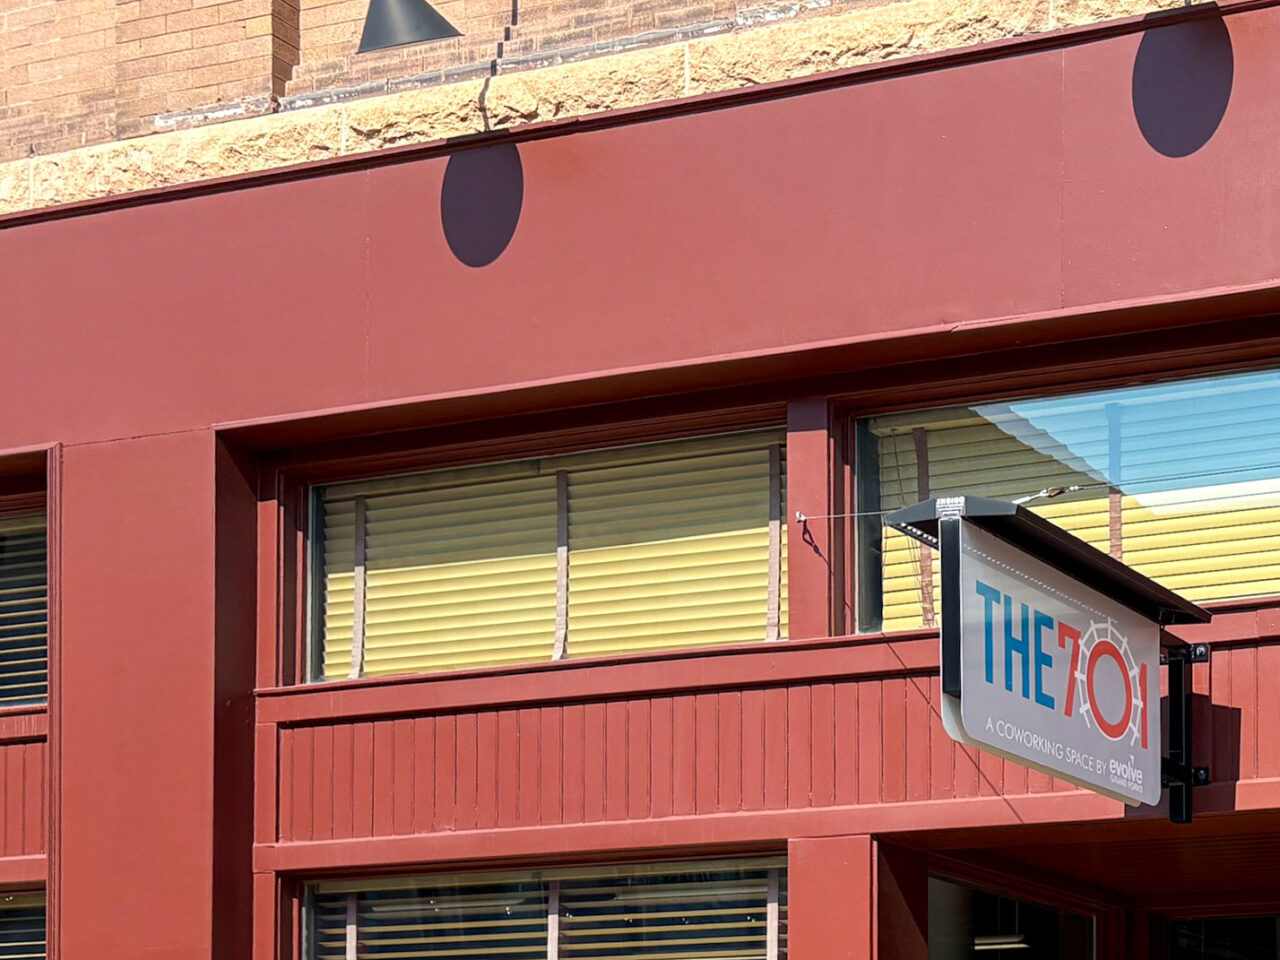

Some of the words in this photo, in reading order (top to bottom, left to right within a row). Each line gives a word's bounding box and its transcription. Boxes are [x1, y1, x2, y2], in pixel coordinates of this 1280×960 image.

[986, 718, 994, 732] A
[996, 721, 1063, 759] COWORKING
[1066, 747, 1093, 772] SPACE
[1097, 760, 1106, 776] BY
[1109, 756, 1142, 784] evolve
